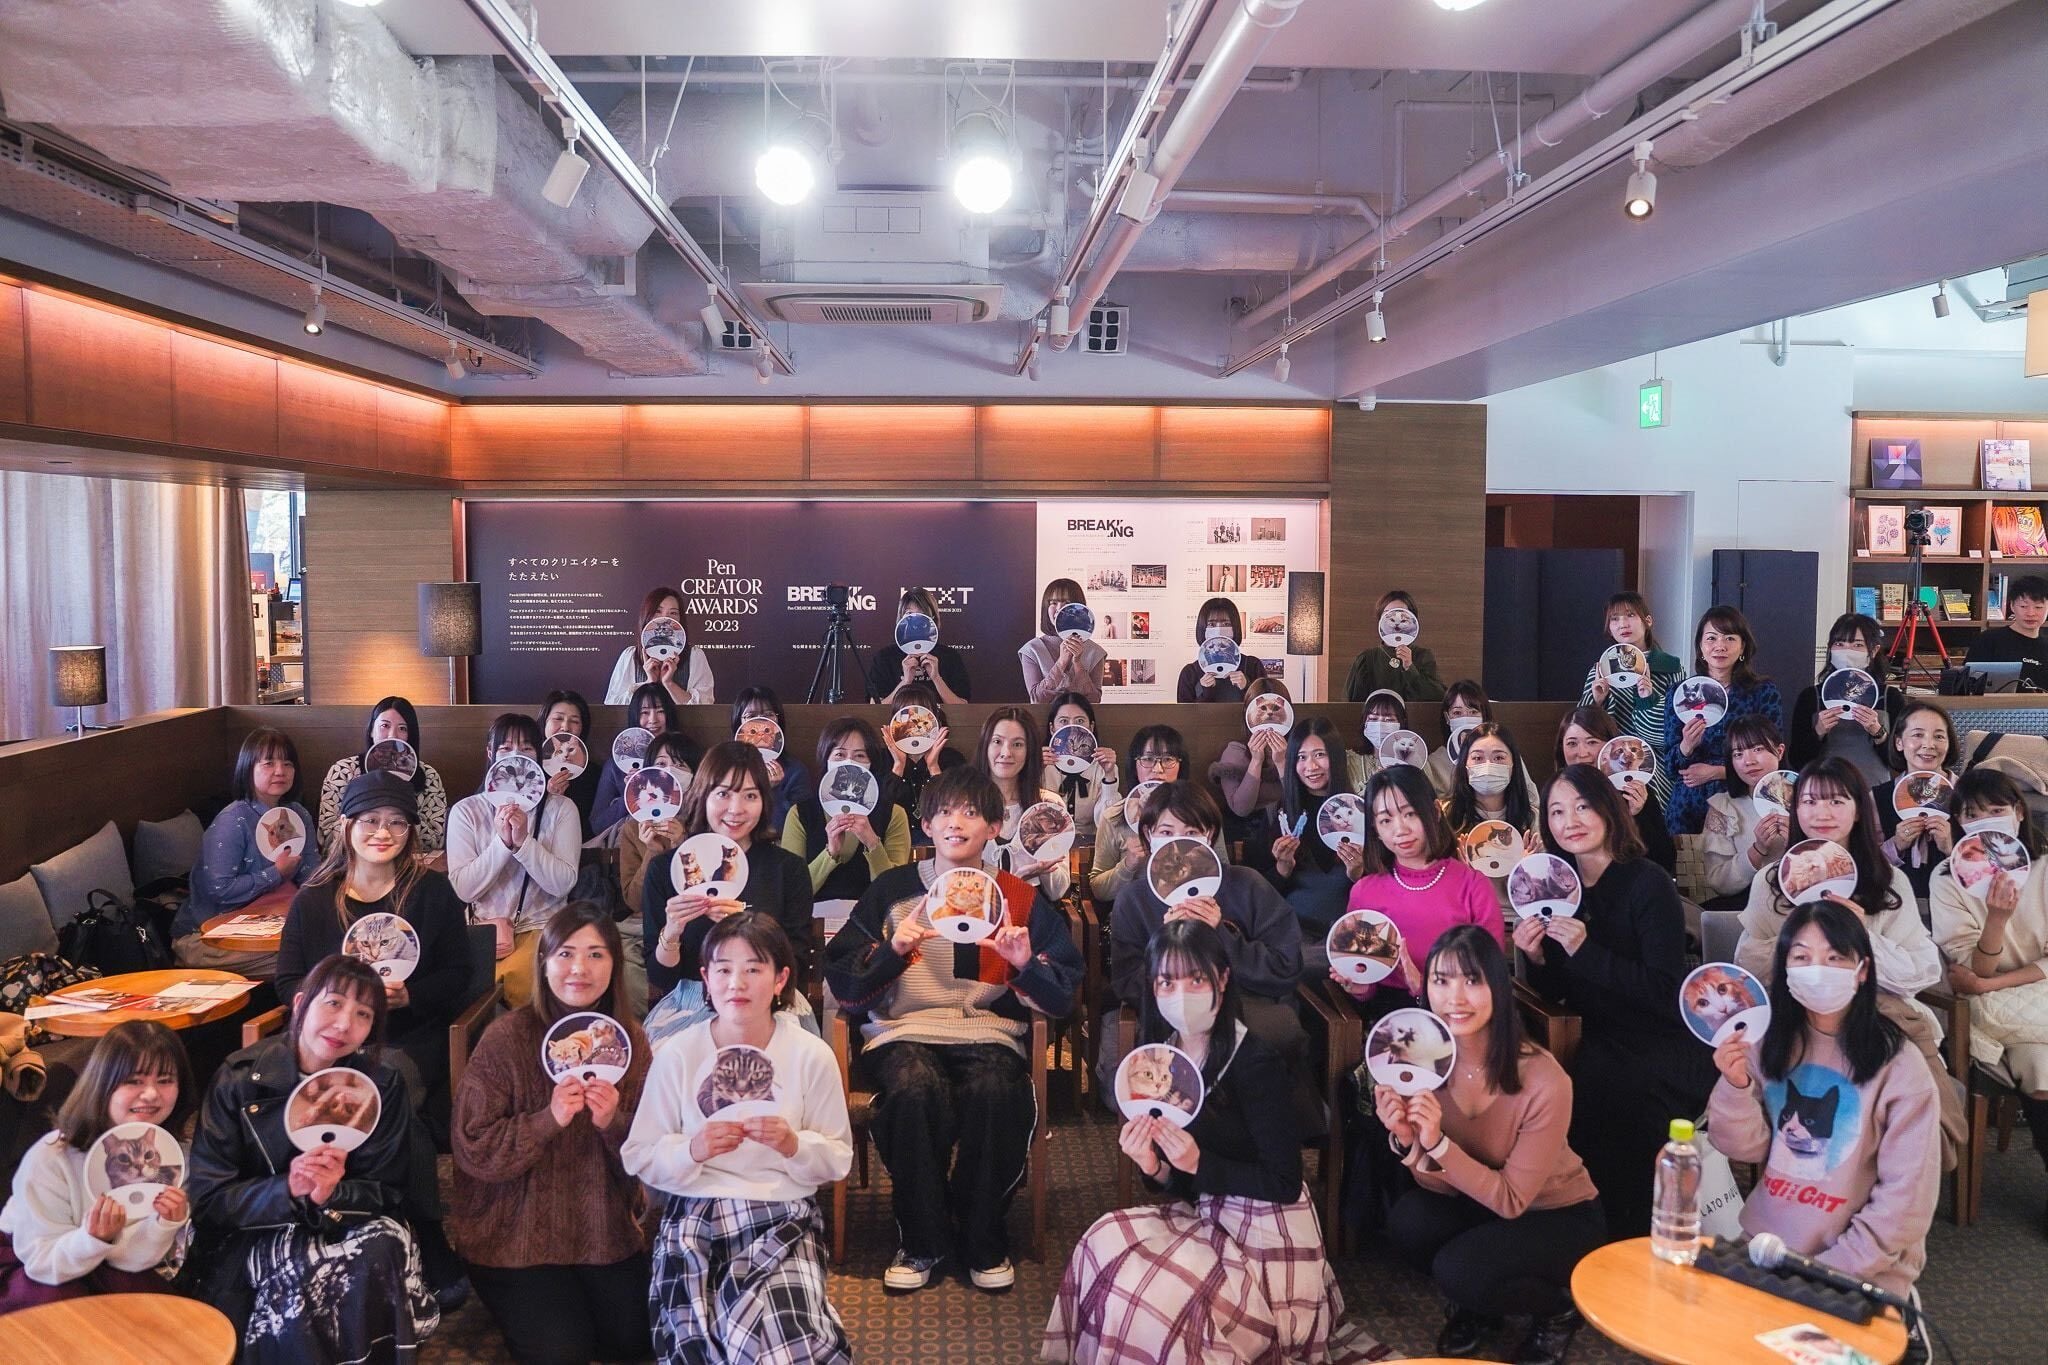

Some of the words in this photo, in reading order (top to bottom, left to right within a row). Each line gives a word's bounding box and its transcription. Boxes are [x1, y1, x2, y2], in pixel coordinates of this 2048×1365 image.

[508, 558, 620, 567] すべてのクリエイターを
[708, 559, 736, 575] Pen
[508, 572, 559, 581] たたえたい
[681, 579, 763, 595] CREATOR
[685, 598, 758, 615] AWARDS
[705, 620, 739, 632] 2023
[1797, 1185, 1849, 1214] CAT
